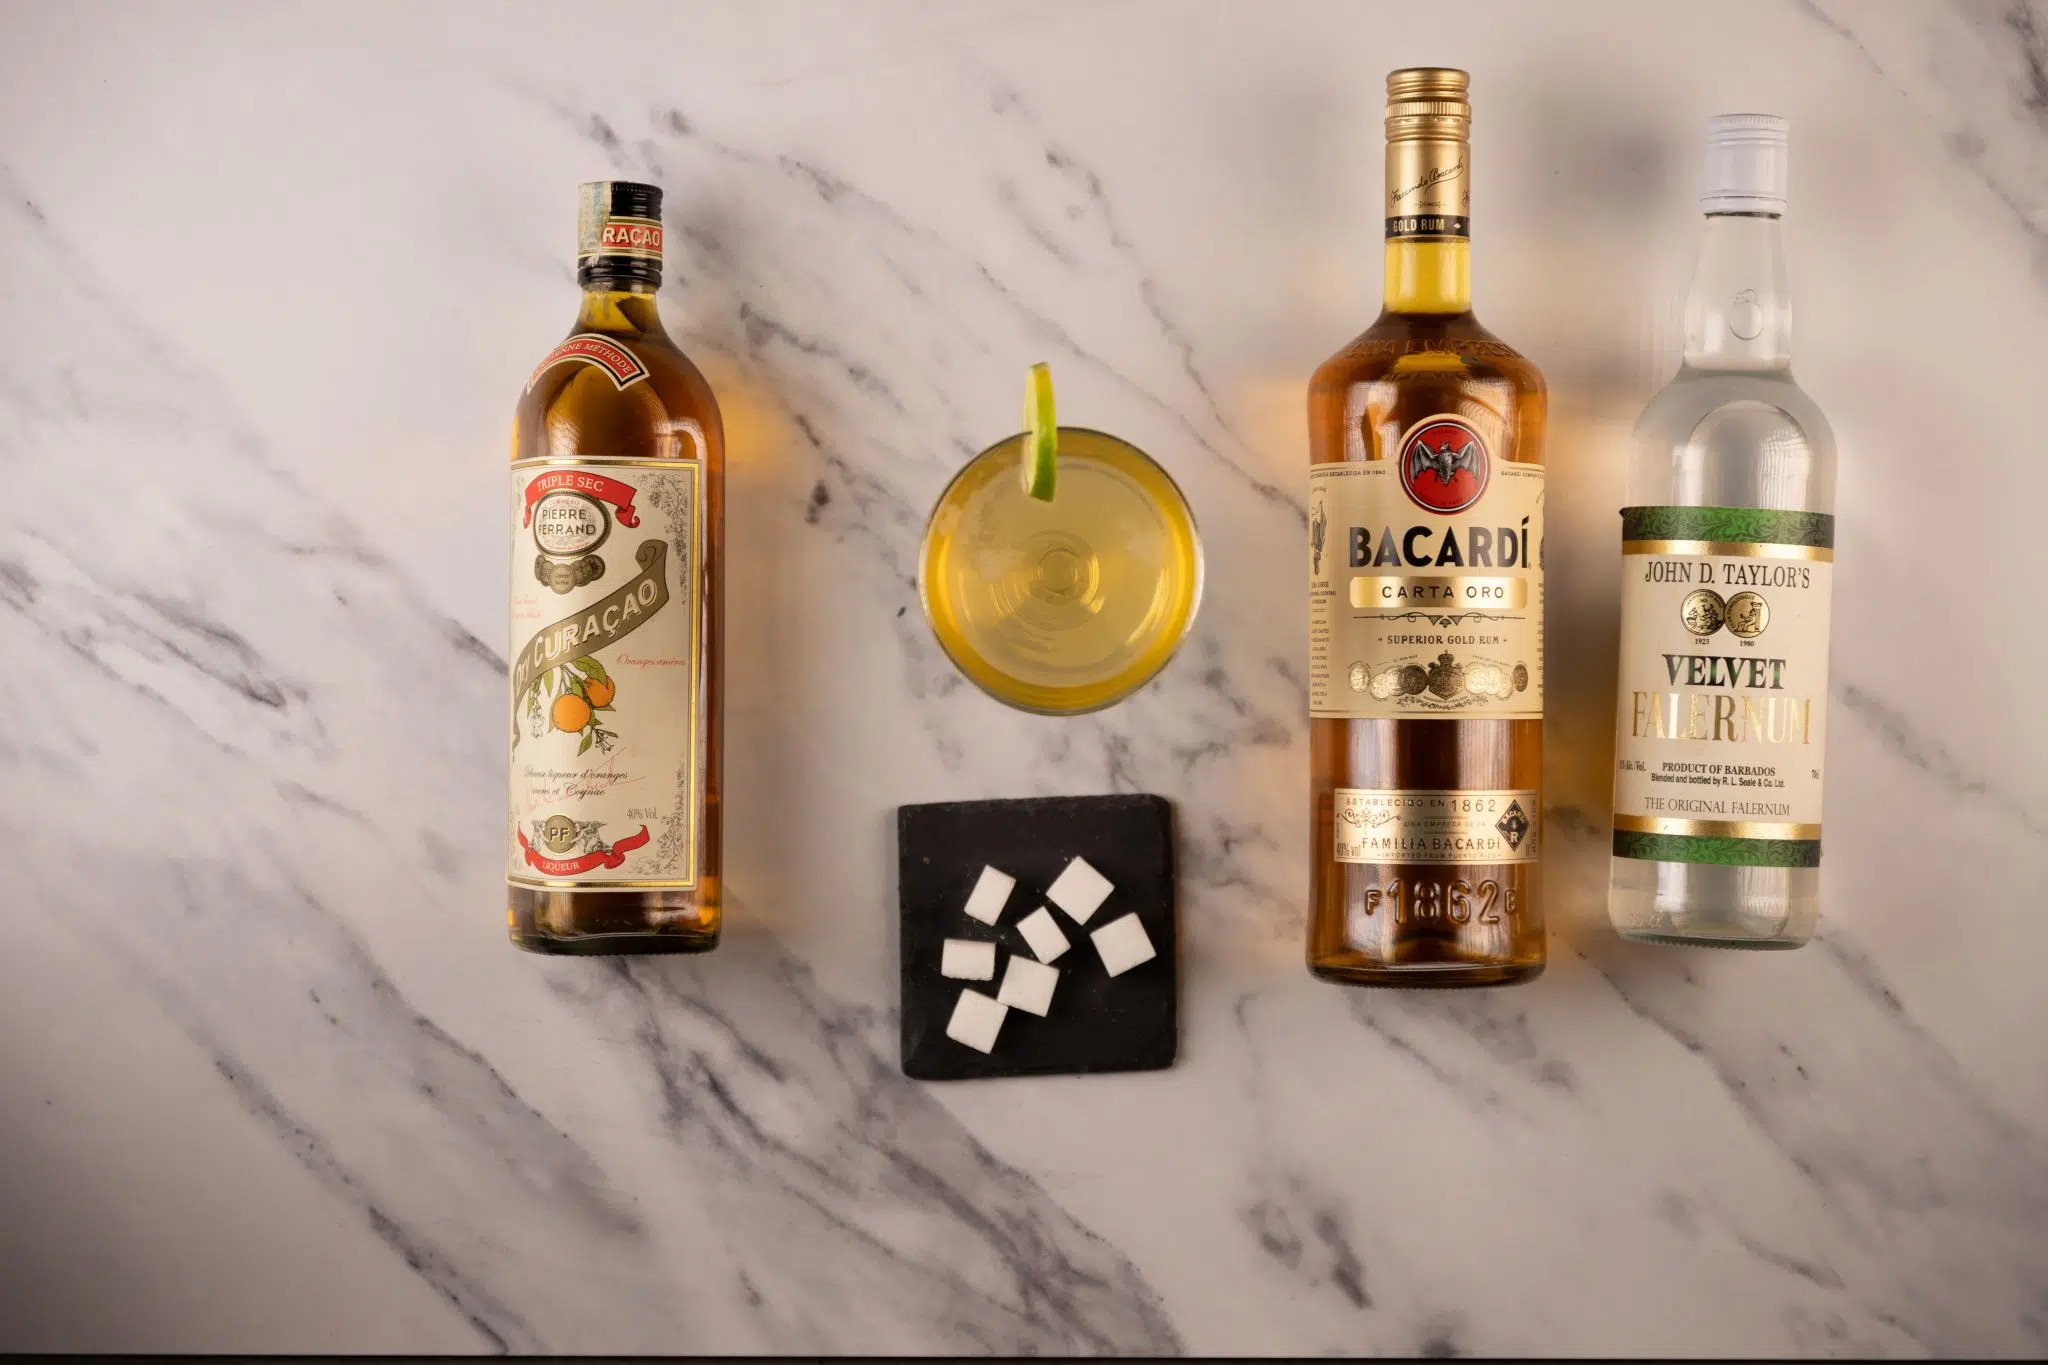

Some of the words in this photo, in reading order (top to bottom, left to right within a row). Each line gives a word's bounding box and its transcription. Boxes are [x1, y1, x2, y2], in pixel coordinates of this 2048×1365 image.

[1393, 219, 1417, 232] GOLD
[1421, 219, 1444, 231] RUM
[583, 343, 632, 373] MÉTHODE
[537, 475, 573, 492] TRIPLE
[577, 476, 604, 492] SEC
[542, 509, 587, 520] PIERRE
[538, 524, 596, 535] FERRAND
[1349, 515, 1530, 568] BACARDÍ
[1645, 562, 1692, 583] JOHN
[1699, 563, 1715, 584] D.
[1723, 564, 1810, 588] TAYLOR'S
[1382, 586, 1454, 598] CARTA
[1466, 586, 1504, 598] ORO
[534, 578, 658, 668] CURAÇAO
[1387, 635, 1443, 645] SUPERIOR
[1447, 635, 1475, 645] GOLD
[1479, 635, 1500, 645] RUM
[616, 654, 655, 669] Oranges
[1662, 654, 1786, 690] VELVET
[1632, 691, 1812, 745] FALERNUM
[1662, 762, 1707, 774] PRODUCT
[1708, 764, 1723, 775] OF
[1724, 765, 1776, 777] BARBADOS
[1651, 773, 1675, 783] Blended
[1675, 775, 1687, 784] and
[1688, 776, 1712, 785] bottled
[1712, 776, 1721, 787] by
[1722, 776, 1730, 786] R.
[1738, 777, 1756, 787] Seale
[1757, 778, 1763, 787] &
[1763, 779, 1774, 788] Co.
[563, 782, 606, 801] Cognac
[1346, 797, 1424, 807] ESTABLECIDO
[1430, 799, 1445, 807] EN
[1451, 799, 1497, 813] 1862
[1644, 796, 1665, 811] THE
[1667, 798, 1728, 814] ORIGINAL
[1731, 801, 1791, 816] FALERNUM
[626, 807, 643, 820] 40%
[1424, 820, 1461, 828] EMPRESA
[549, 827, 570, 843] PF
[1510, 831, 1519, 842] R
[1362, 838, 1427, 850] FAMILIA
[541, 861, 580, 873] LIQUEUR
[1387, 879, 1500, 925] 1862
